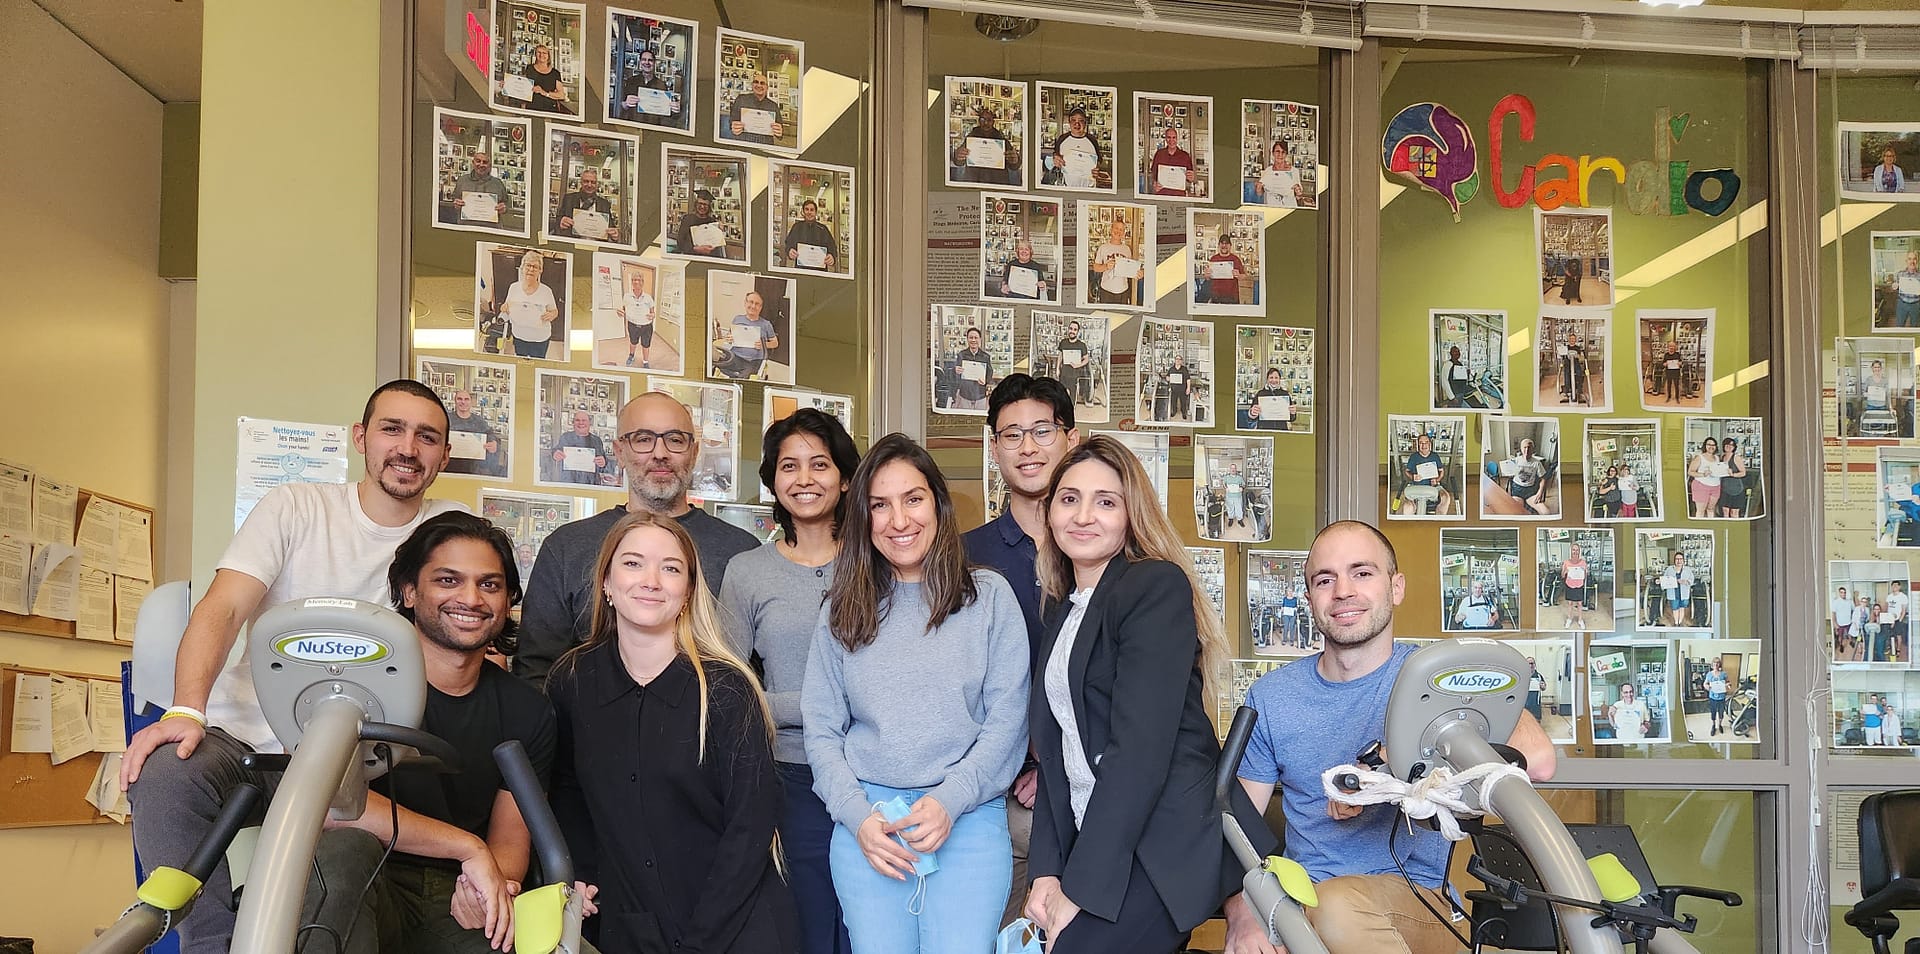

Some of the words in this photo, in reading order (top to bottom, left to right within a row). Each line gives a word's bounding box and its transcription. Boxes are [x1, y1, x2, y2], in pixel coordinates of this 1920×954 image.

[1488, 93, 1741, 217] Cardio
[272, 426, 316, 436] Nettoyez-vous
[297, 640, 367, 658] NuStep
[1448, 674, 1502, 688] NuStep
